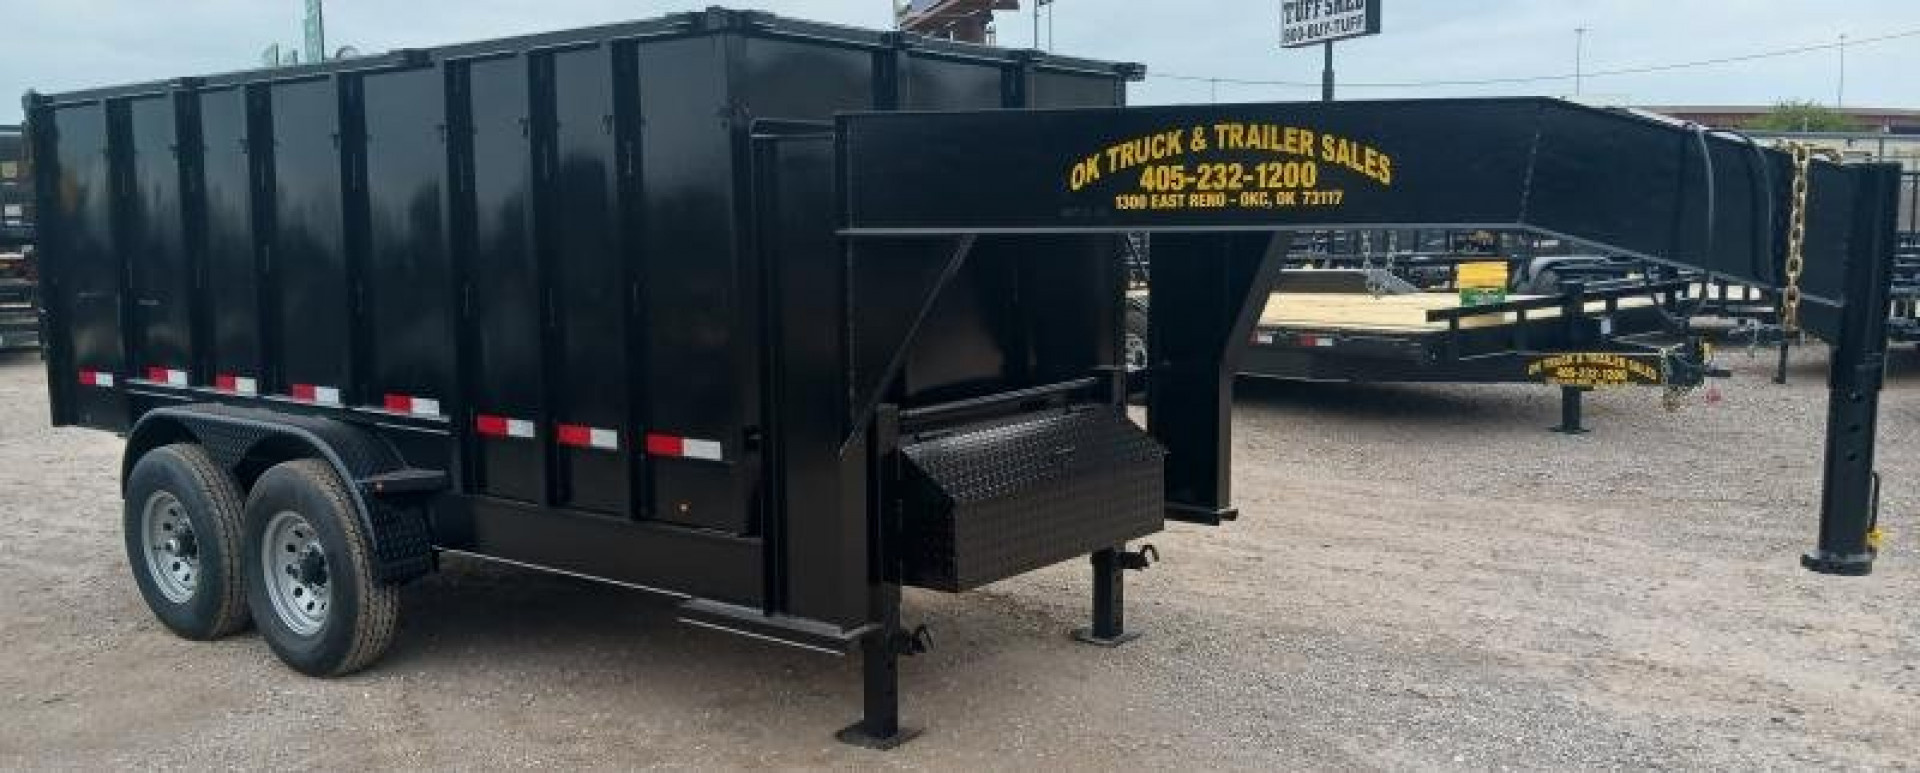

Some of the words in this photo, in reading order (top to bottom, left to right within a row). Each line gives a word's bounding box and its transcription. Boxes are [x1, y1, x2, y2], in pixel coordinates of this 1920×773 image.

[1070, 154, 1101, 191] OK
[1105, 128, 1184, 174] TRUCK
[1189, 126, 1207, 153] &
[1214, 123, 1315, 157] TRAILER
[1321, 133, 1393, 187] SALES
[1140, 160, 1317, 192] 405-232-1200
[1115, 194, 1148, 210] 1300
[1151, 192, 1185, 209] EAST
[1189, 191, 1226, 208] RENO
[1240, 191, 1273, 209] OKC,
[1276, 191, 1298, 207] OK
[1302, 190, 1344, 207] 73117
